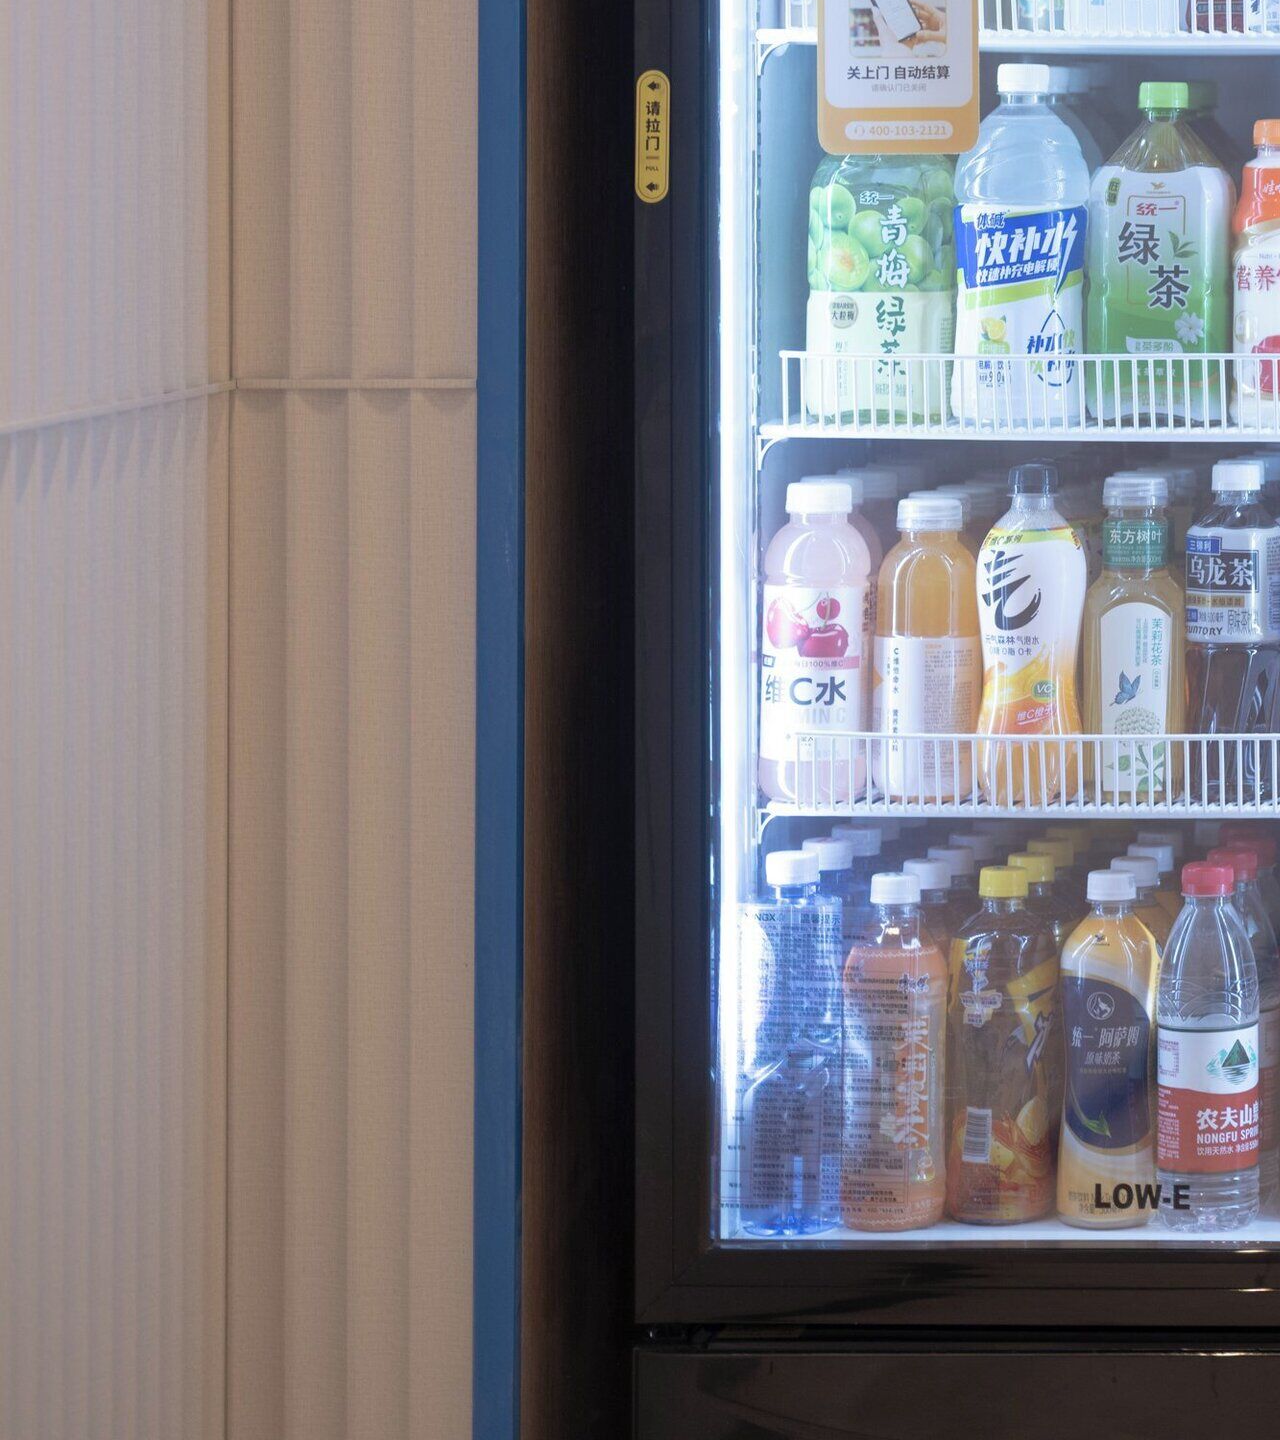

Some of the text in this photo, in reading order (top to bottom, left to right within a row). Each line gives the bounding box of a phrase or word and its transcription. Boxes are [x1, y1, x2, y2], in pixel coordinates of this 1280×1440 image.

[847, 66, 950, 80] 关上门 自动结算
[645, 100, 661, 151] 请拉门
[869, 126, 947, 136] 400-103-2121
[859, 190, 895, 205] 统一
[1136, 202, 1177, 216] 统一
[974, 213, 1077, 268] 快补水
[1118, 221, 1190, 308] 绿茶
[1109, 529, 1163, 544] 东方树叶
[1188, 555, 1254, 587] 乌龙茶
[985, 635, 1040, 645] 元气森林 气泡水
[1151, 618, 1164, 666] 茉莉花茶
[1098, 1026, 1140, 1048] 阿萨姆
[1196, 1131, 1238, 1145] NONGFU
[1197, 1146, 1234, 1156] 饮用天然水
[1094, 1183, 1190, 1210] LOW-E
